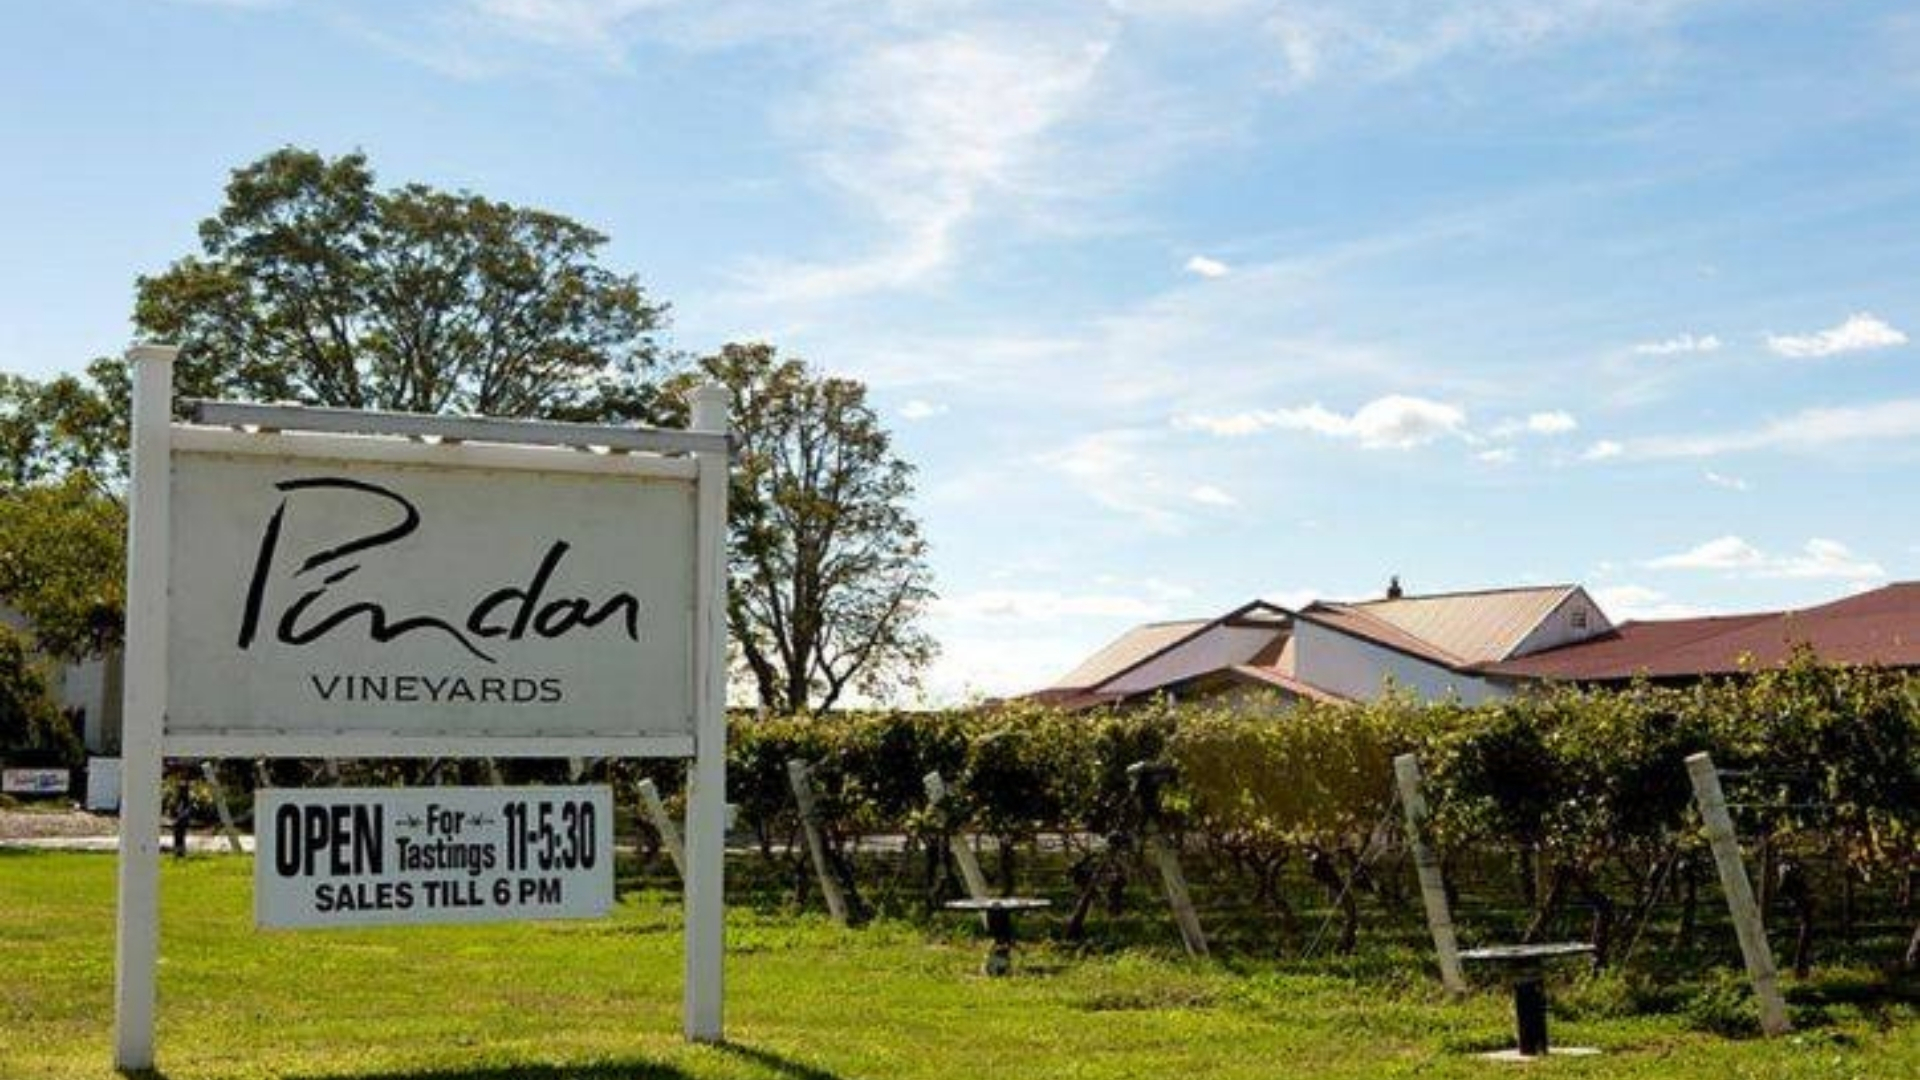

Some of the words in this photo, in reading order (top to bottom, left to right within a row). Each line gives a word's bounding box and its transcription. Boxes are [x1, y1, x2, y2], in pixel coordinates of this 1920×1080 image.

[312, 675, 562, 702] VINEYARDS
[275, 803, 383, 877] OPEN
[426, 804, 465, 834] For
[503, 801, 596, 871] 11-5:30
[396, 838, 496, 876] Tastings
[315, 883, 414, 912] SALES
[423, 881, 483, 907] TILL
[493, 880, 510, 905] 6
[519, 879, 562, 904] PM
